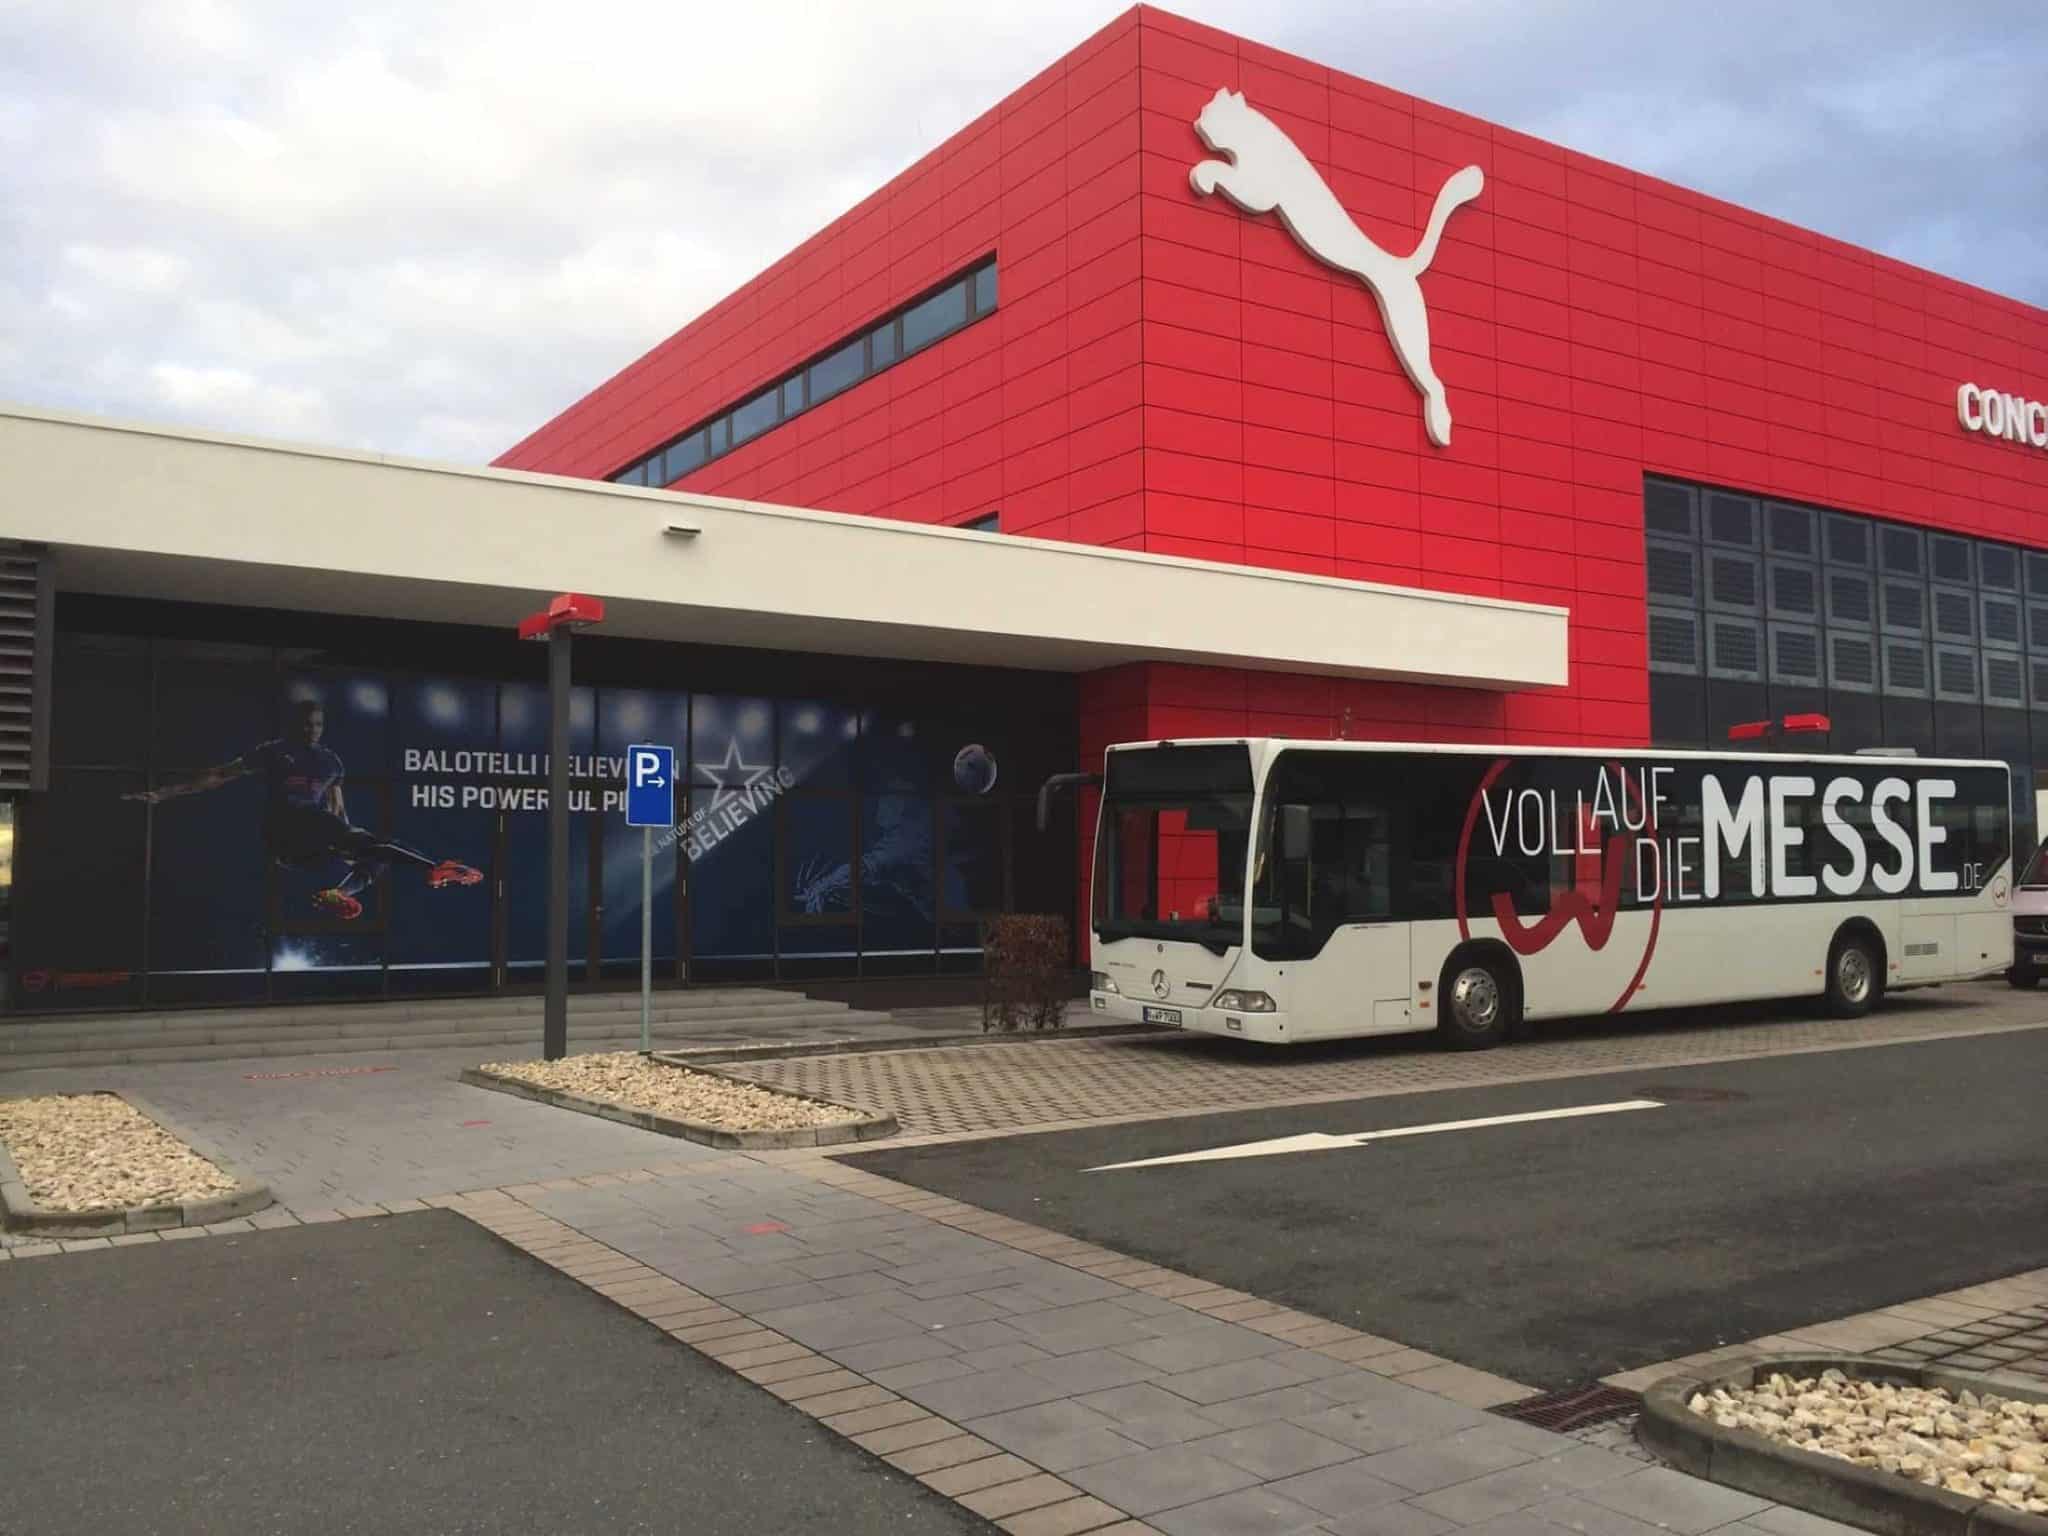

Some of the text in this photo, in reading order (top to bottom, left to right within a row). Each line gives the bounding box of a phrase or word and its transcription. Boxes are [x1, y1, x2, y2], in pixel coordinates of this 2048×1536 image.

[1957, 382, 2048, 448] CONC
[404, 749, 537, 776] BALOTELLI
[635, 752, 661, 787] P
[412, 784, 456, 809] HIS
[462, 786, 599, 812] POWERUL
[680, 766, 796, 862] BELIEVING
[1481, 766, 1674, 858] VOLL AUF
[1636, 837, 1700, 902] DIE
[1701, 774, 1958, 899] MESSE
